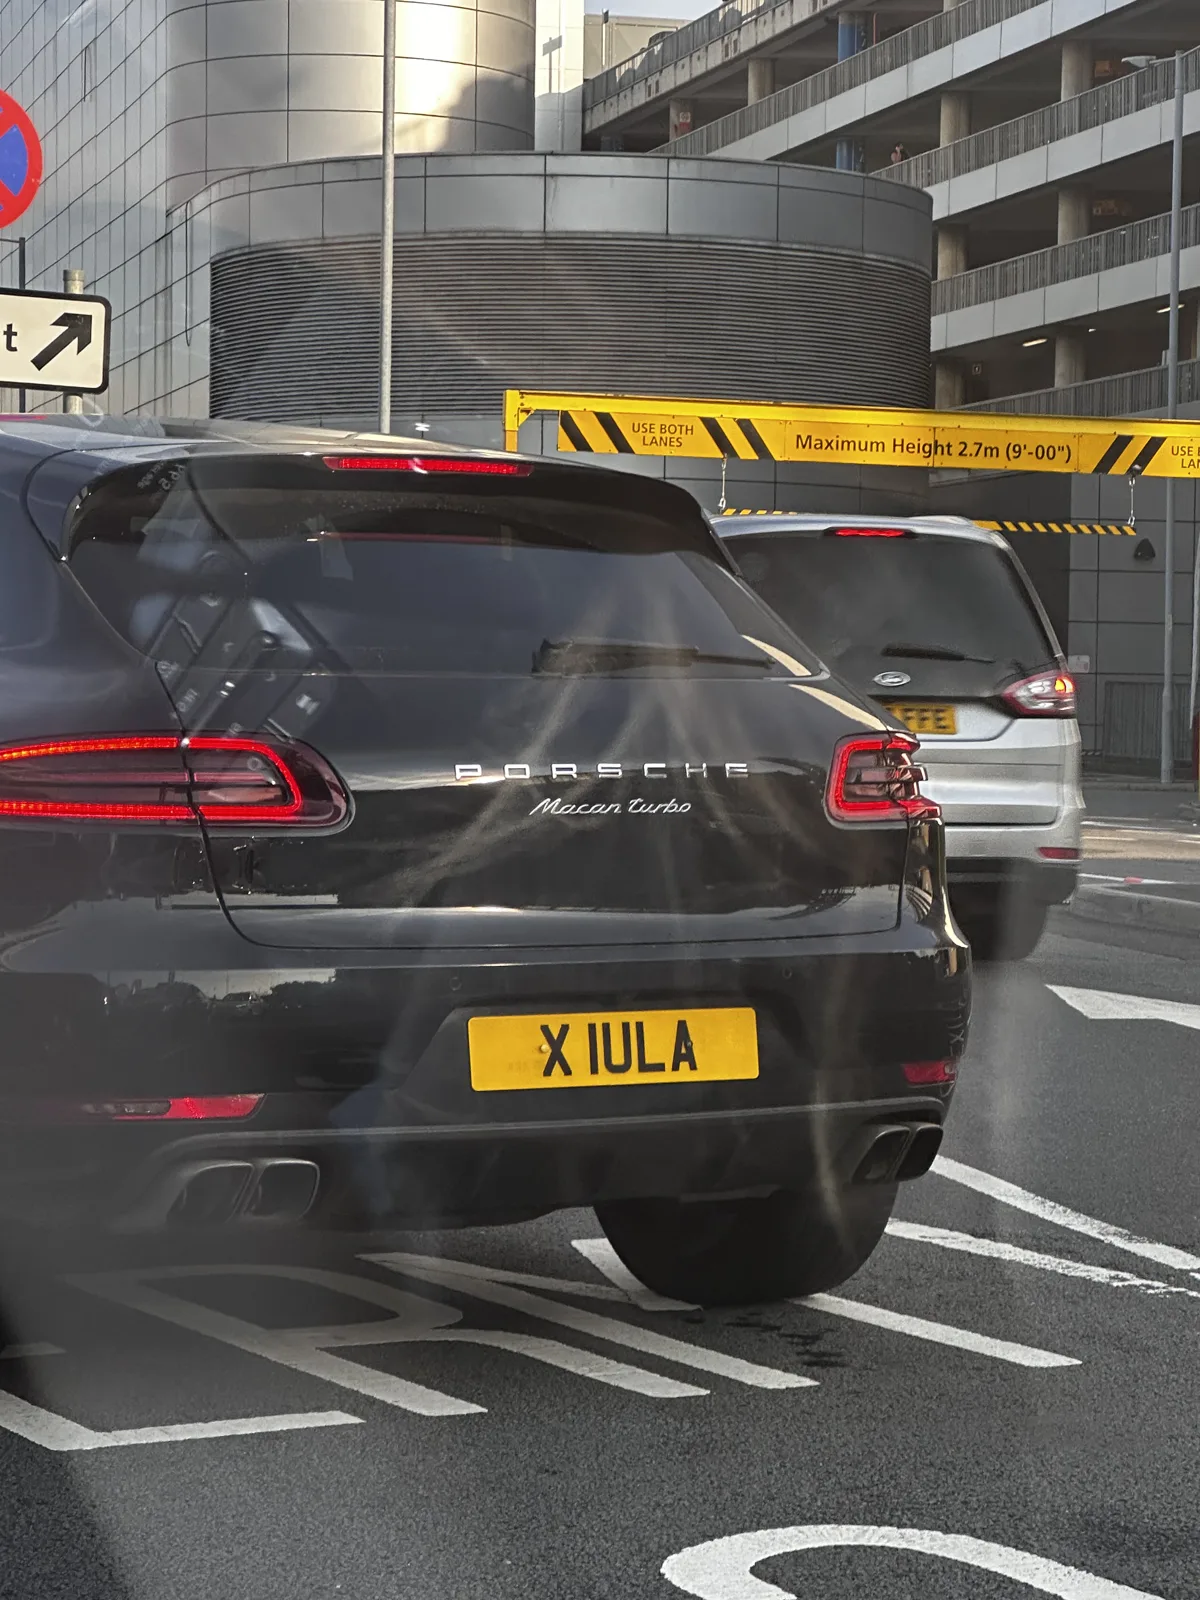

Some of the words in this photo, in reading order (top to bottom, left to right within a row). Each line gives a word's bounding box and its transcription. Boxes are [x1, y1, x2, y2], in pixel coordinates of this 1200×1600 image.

[631, 422, 656, 435] USE
[659, 423, 694, 436] BOTH
[641, 436, 683, 448] LANES
[795, 434, 886, 453] Maximum
[892, 438, 953, 459] Height
[958, 441, 1000, 459] 2.7m
[1171, 445, 1194, 457] USE
[454, 763, 749, 780] PORSCHE
[529, 798, 622, 815] Macan
[627, 798, 692, 814] turbo
